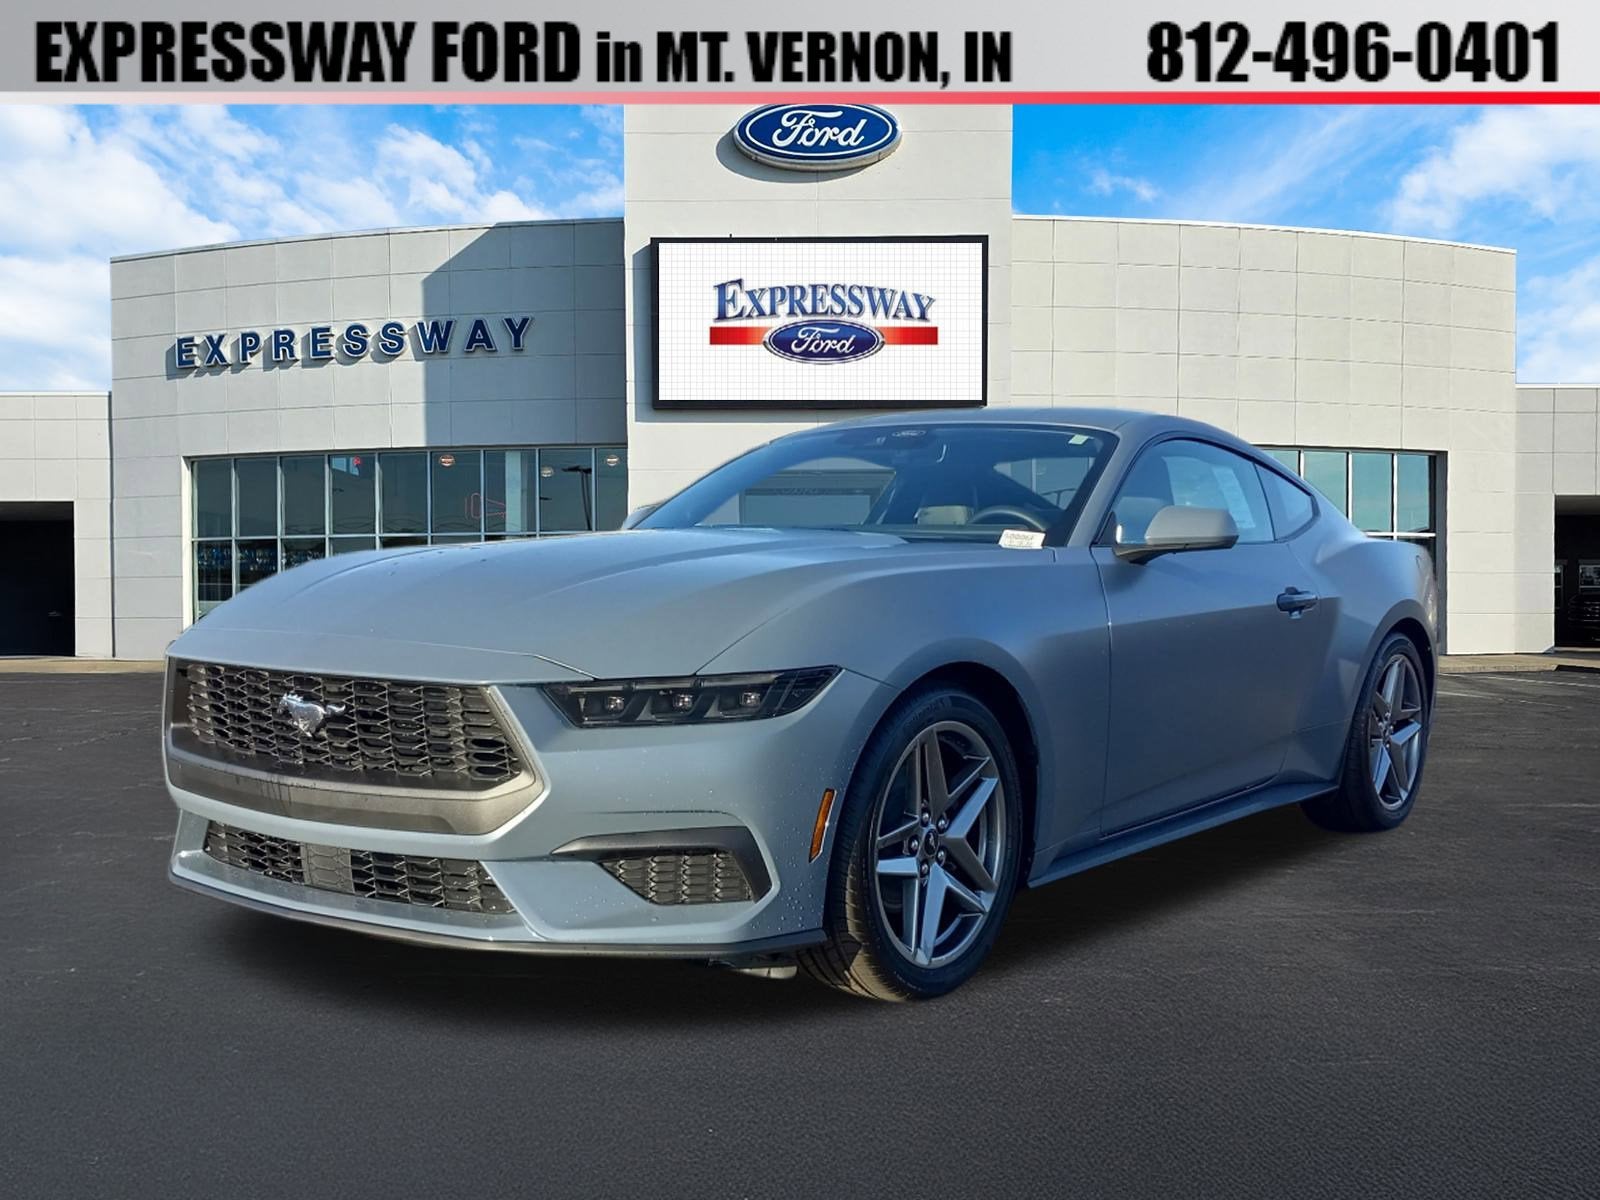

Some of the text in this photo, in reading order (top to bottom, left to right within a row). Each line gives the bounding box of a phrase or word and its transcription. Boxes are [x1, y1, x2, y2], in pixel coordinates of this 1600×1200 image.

[772, 110, 868, 147] Ford
[175, 316, 533, 368] EXPRESSWAY
[790, 326, 856, 354] Ford
